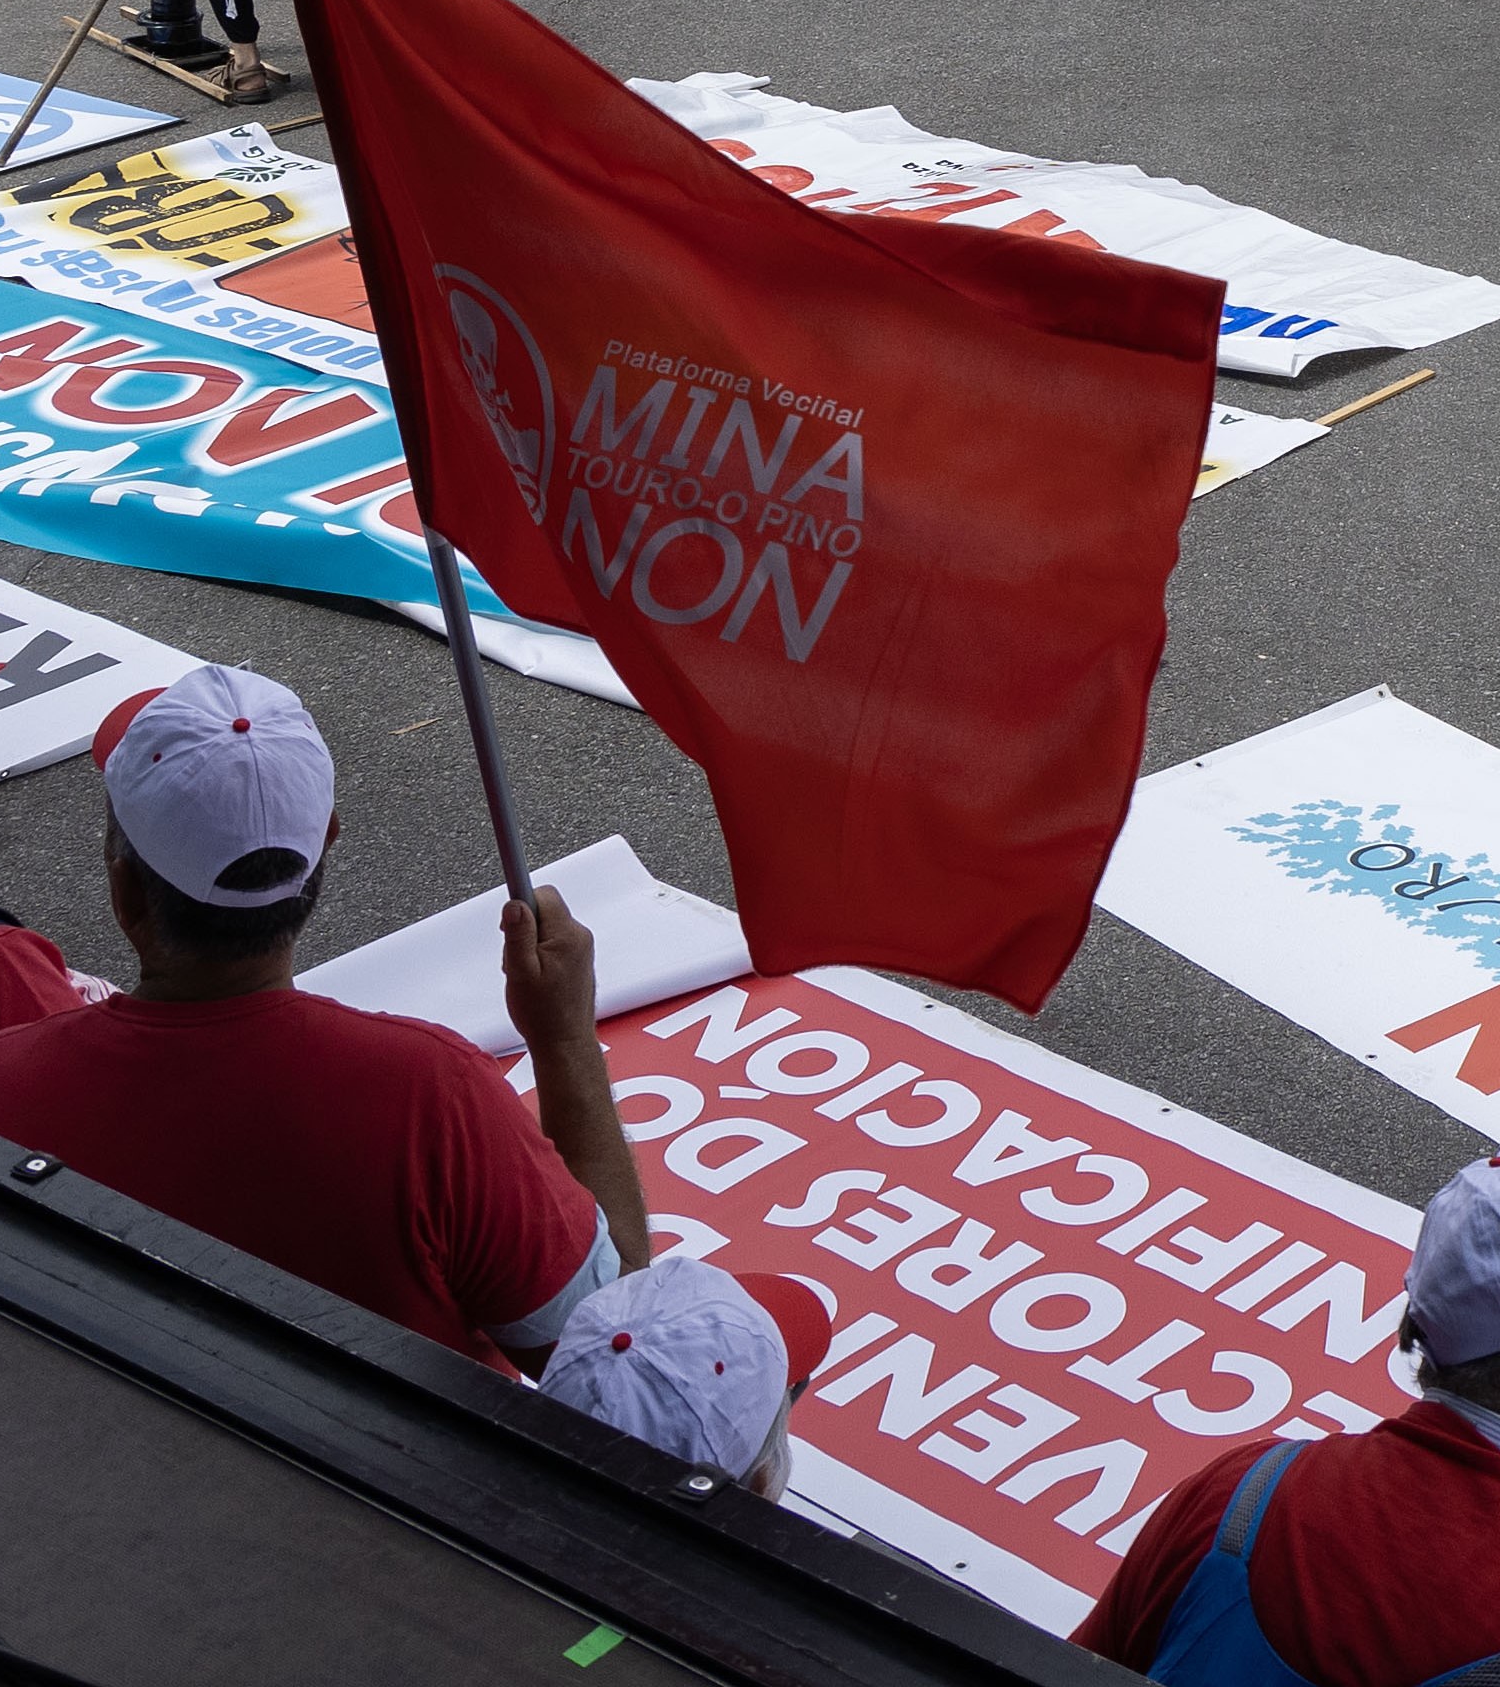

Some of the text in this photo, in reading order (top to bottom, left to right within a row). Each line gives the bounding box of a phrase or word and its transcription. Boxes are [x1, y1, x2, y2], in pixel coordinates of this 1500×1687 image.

[569, 364, 864, 522] MINA
[602, 339, 864, 429] Plataforma Veciñal
[567, 446, 863, 558] TOURO-O PINO
[561, 486, 854, 663] NON
